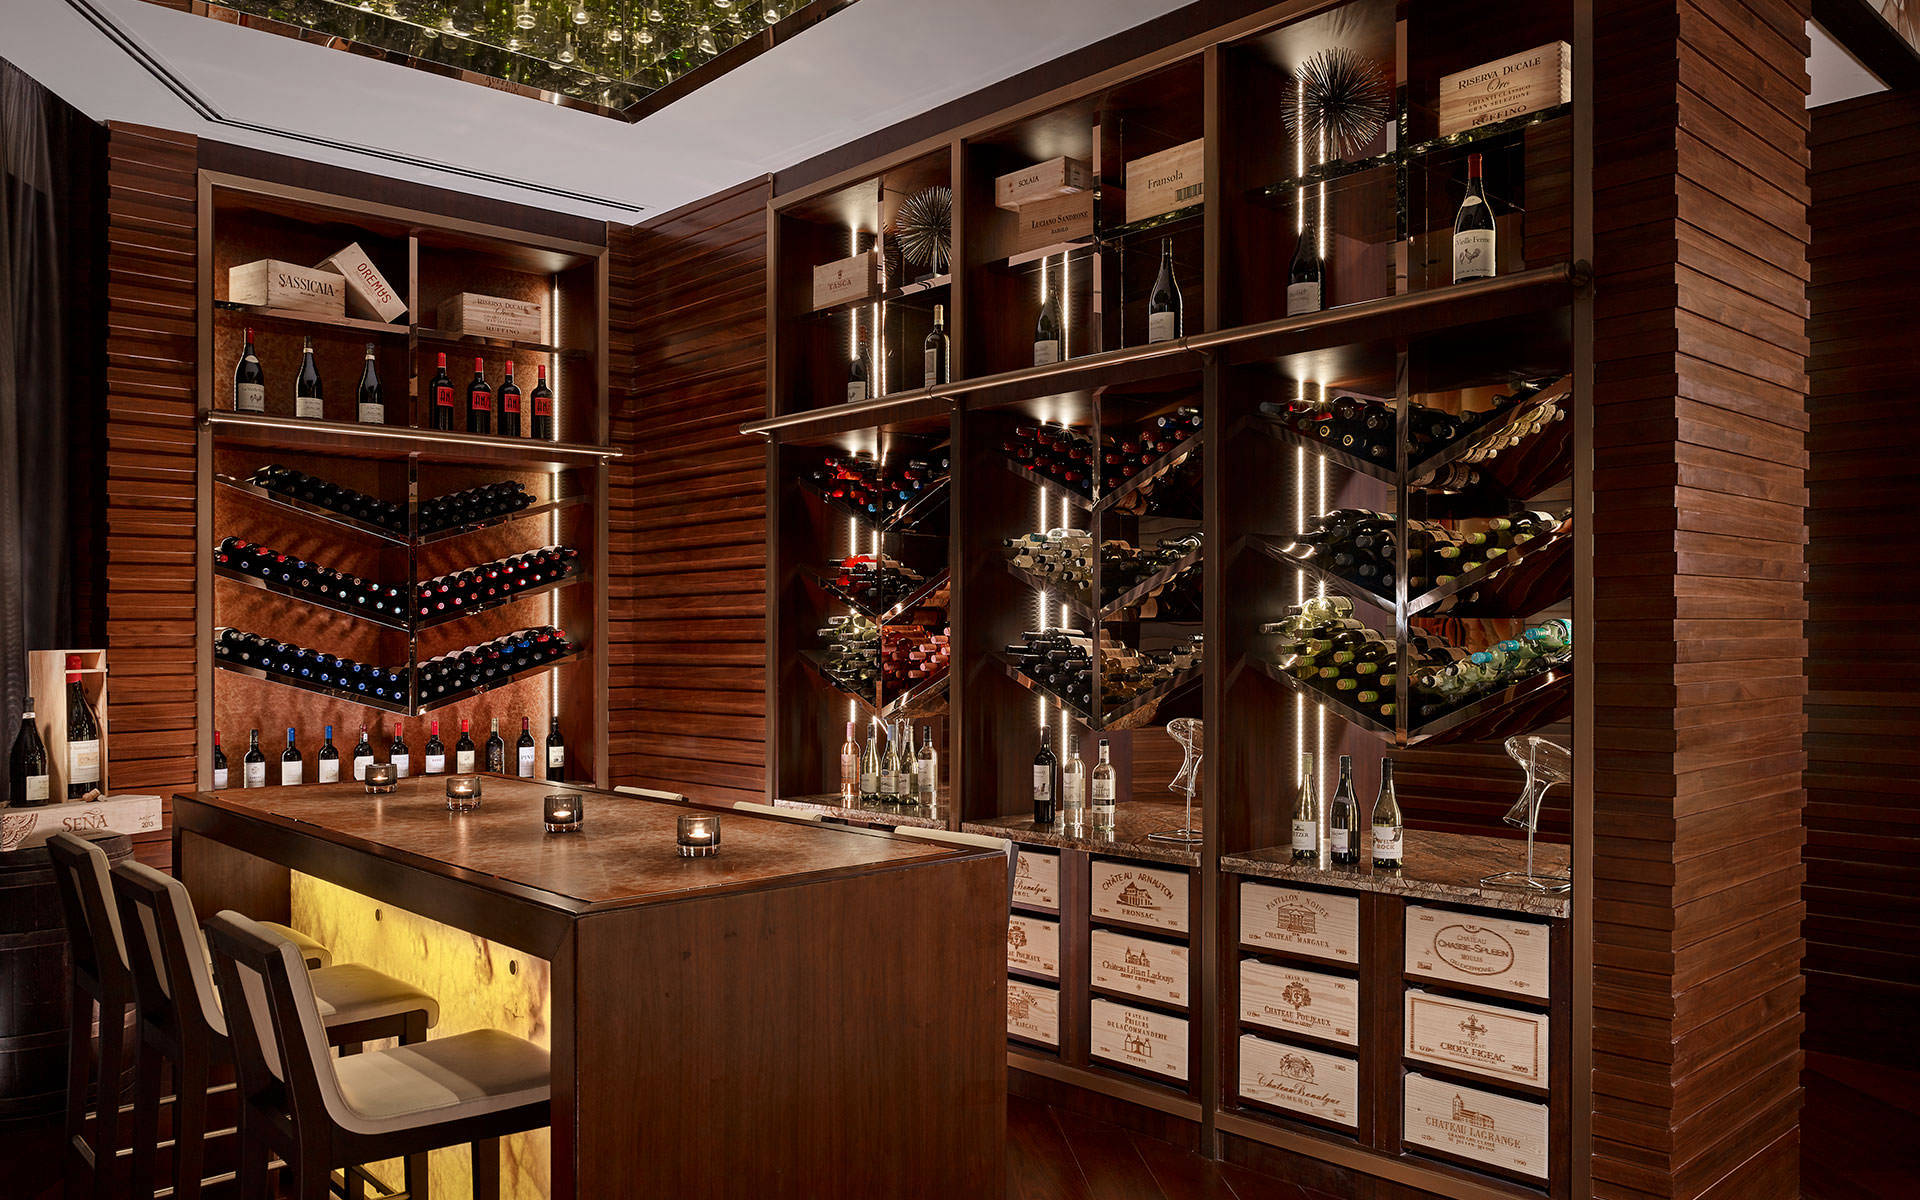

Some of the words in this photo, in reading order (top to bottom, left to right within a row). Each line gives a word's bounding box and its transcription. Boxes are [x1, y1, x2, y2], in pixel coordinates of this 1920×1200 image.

[1458, 71, 1498, 90] RISERVA
[1503, 56, 1541, 75] DUCALE
[1472, 105, 1527, 126] RUFFINO
[1018, 175, 1040, 188] SOLAIA
[1147, 169, 1183, 190] Fransola
[1031, 217, 1057, 229] LUCIANO
[278, 273, 335, 297] SASSICAIA
[356, 262, 392, 304] OREMUS
[1121, 908, 1155, 920] FRONSAC
[1440, 1041, 1469, 1055] CROIX
[1471, 1048, 1506, 1063] FIGEAC
[1425, 1116, 1468, 1135] CHATEAU
[1468, 1127, 1522, 1149] LAGRANGE
